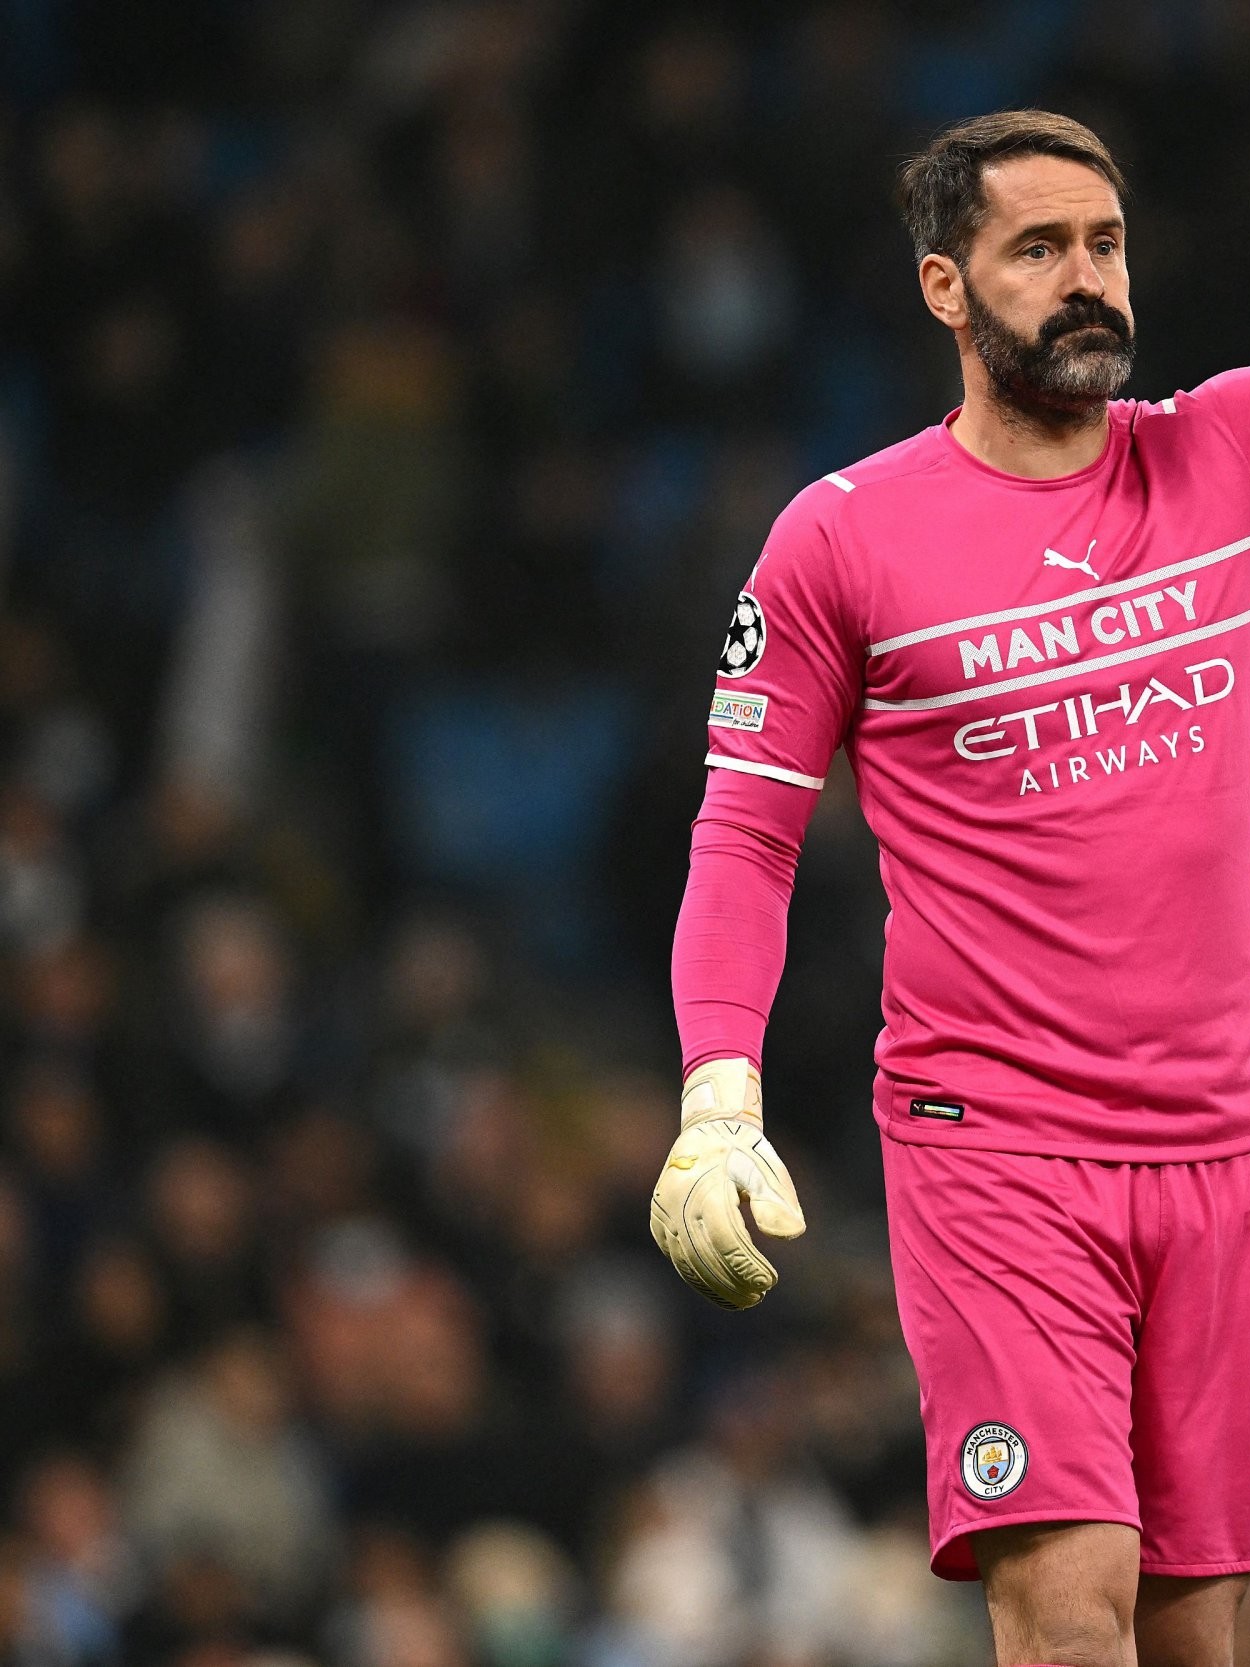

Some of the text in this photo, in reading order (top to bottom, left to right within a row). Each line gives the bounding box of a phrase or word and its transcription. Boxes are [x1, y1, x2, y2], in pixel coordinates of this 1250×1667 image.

[958, 580, 1198, 679] MAN CITY
[953, 657, 1236, 760] ETIHAD
[1019, 725, 1206, 796] AIRWAYS
[967, 1428, 1019, 1455] MANCHESTER
[985, 1485, 1004, 1495] CITY
